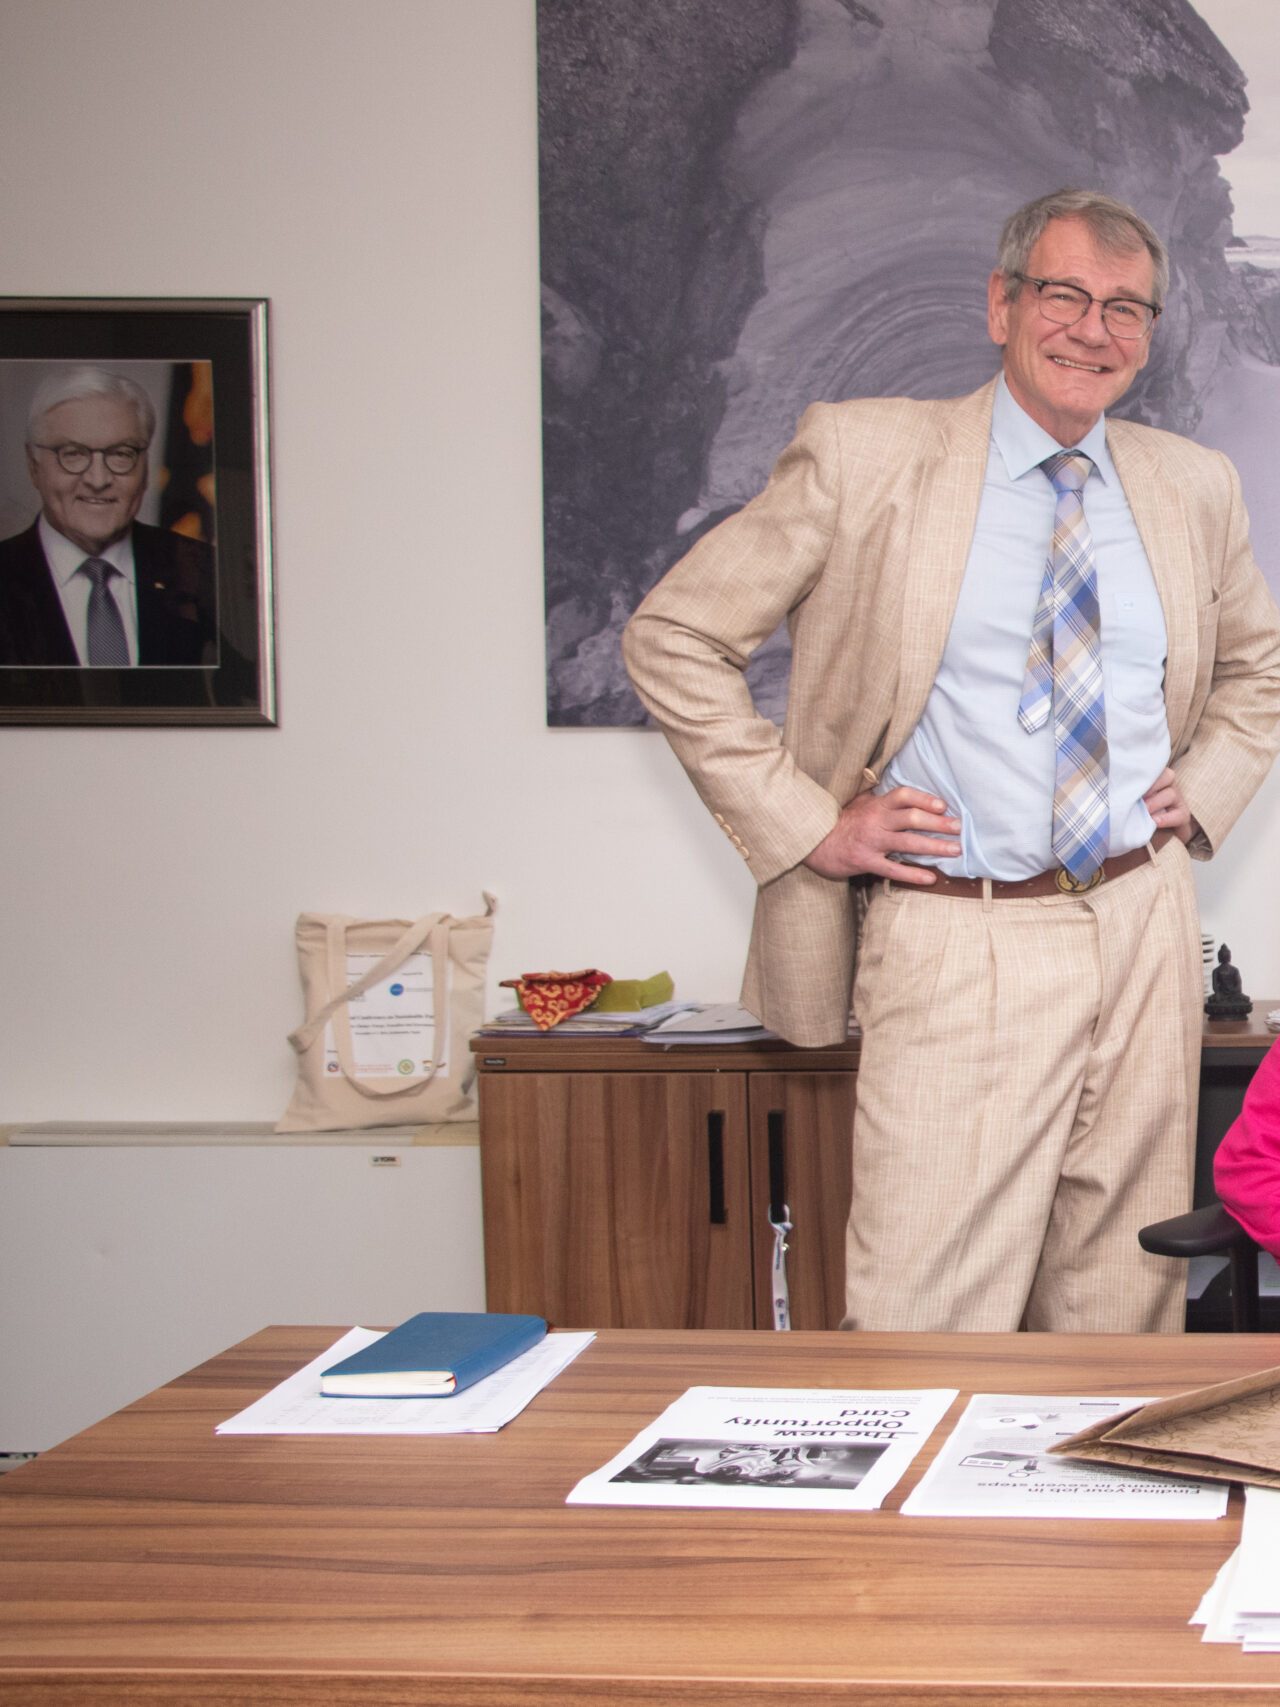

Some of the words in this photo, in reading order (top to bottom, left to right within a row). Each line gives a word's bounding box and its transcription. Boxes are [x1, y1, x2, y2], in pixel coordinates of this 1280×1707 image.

[839, 1409, 911, 1418] Card
[723, 1416, 904, 1429] Opportunity
[774, 1429, 836, 1438] new
[845, 1430, 900, 1440] The
